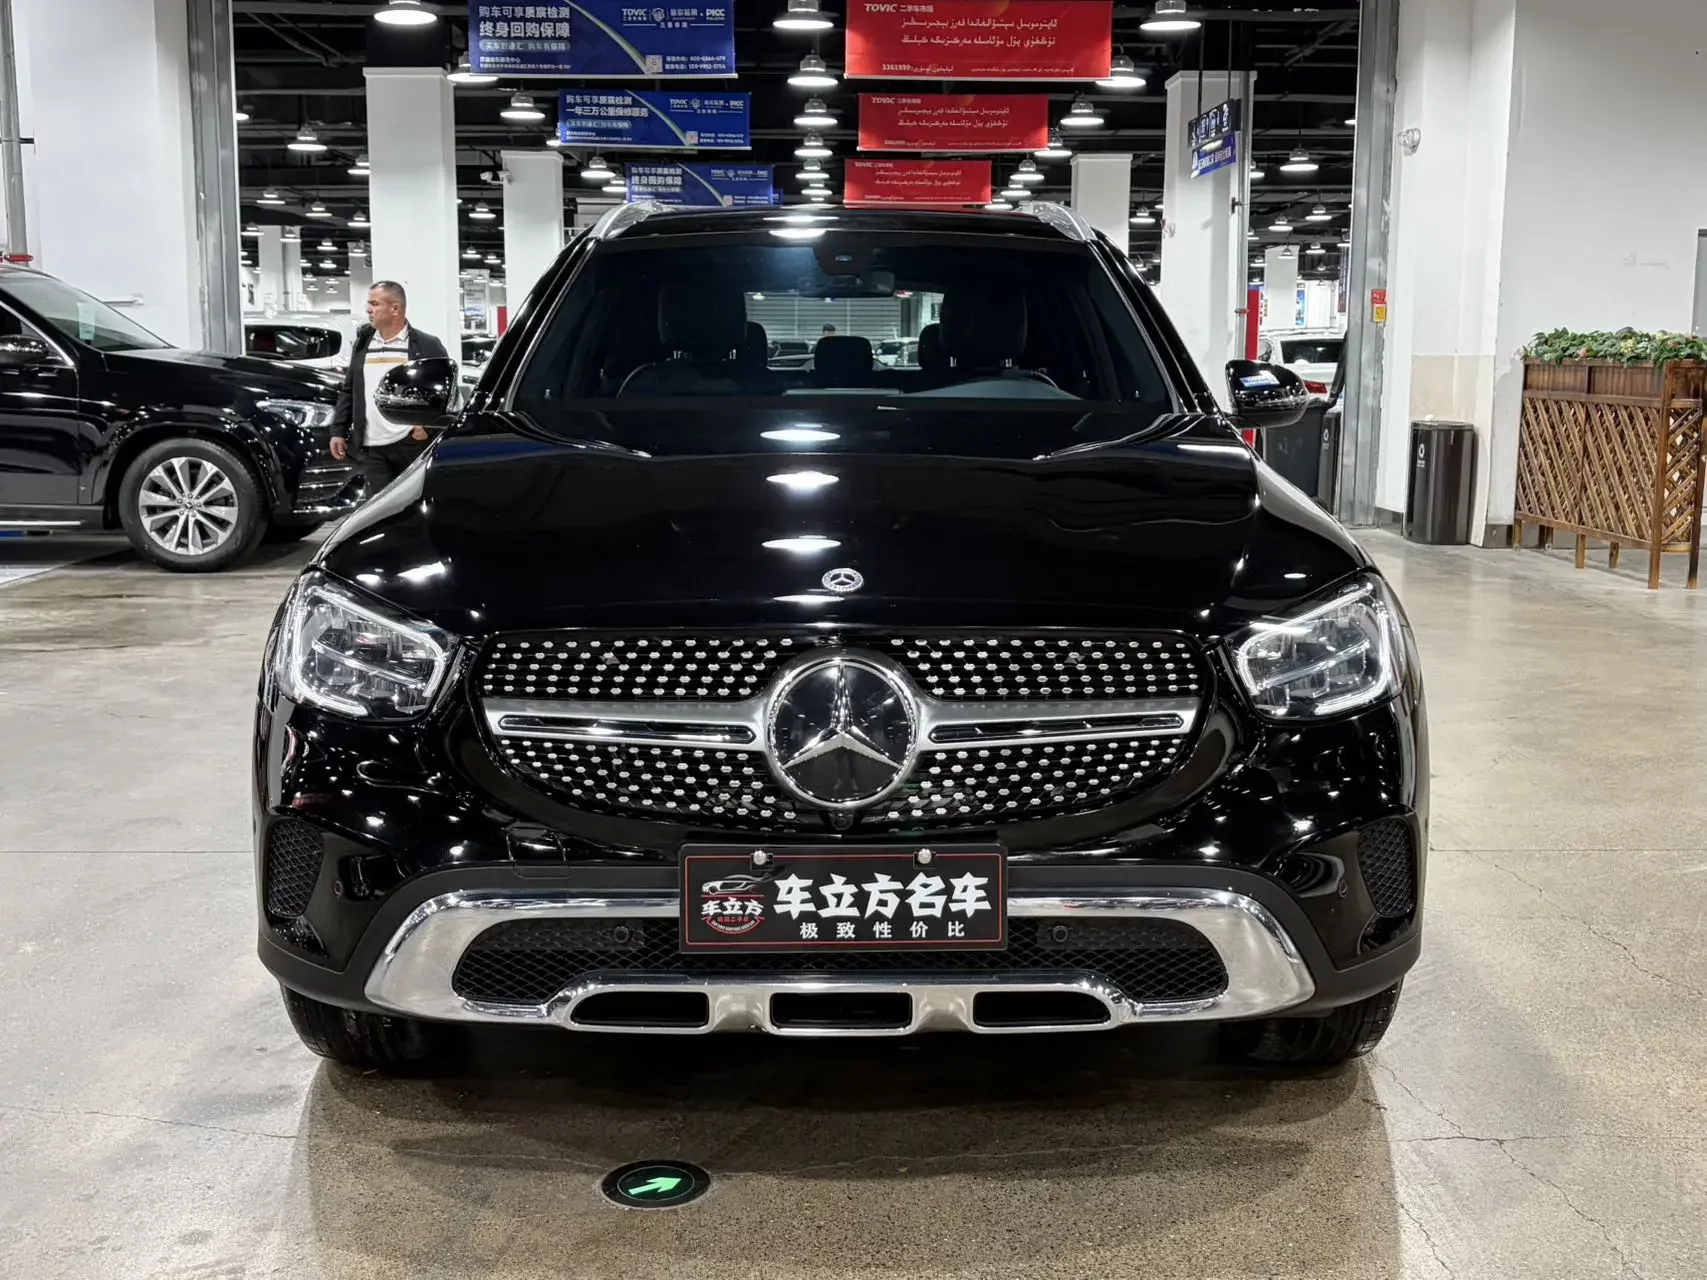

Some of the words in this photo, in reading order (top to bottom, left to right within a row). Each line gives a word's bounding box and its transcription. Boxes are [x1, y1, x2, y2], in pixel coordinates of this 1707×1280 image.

[864, 3, 898, 12] TOVIC
[479, 21, 571, 38] 终身回购保障
[773, 871, 992, 920] 车立方名车
[701, 896, 764, 916] 车立方
[799, 921, 966, 939] 极致性价比
